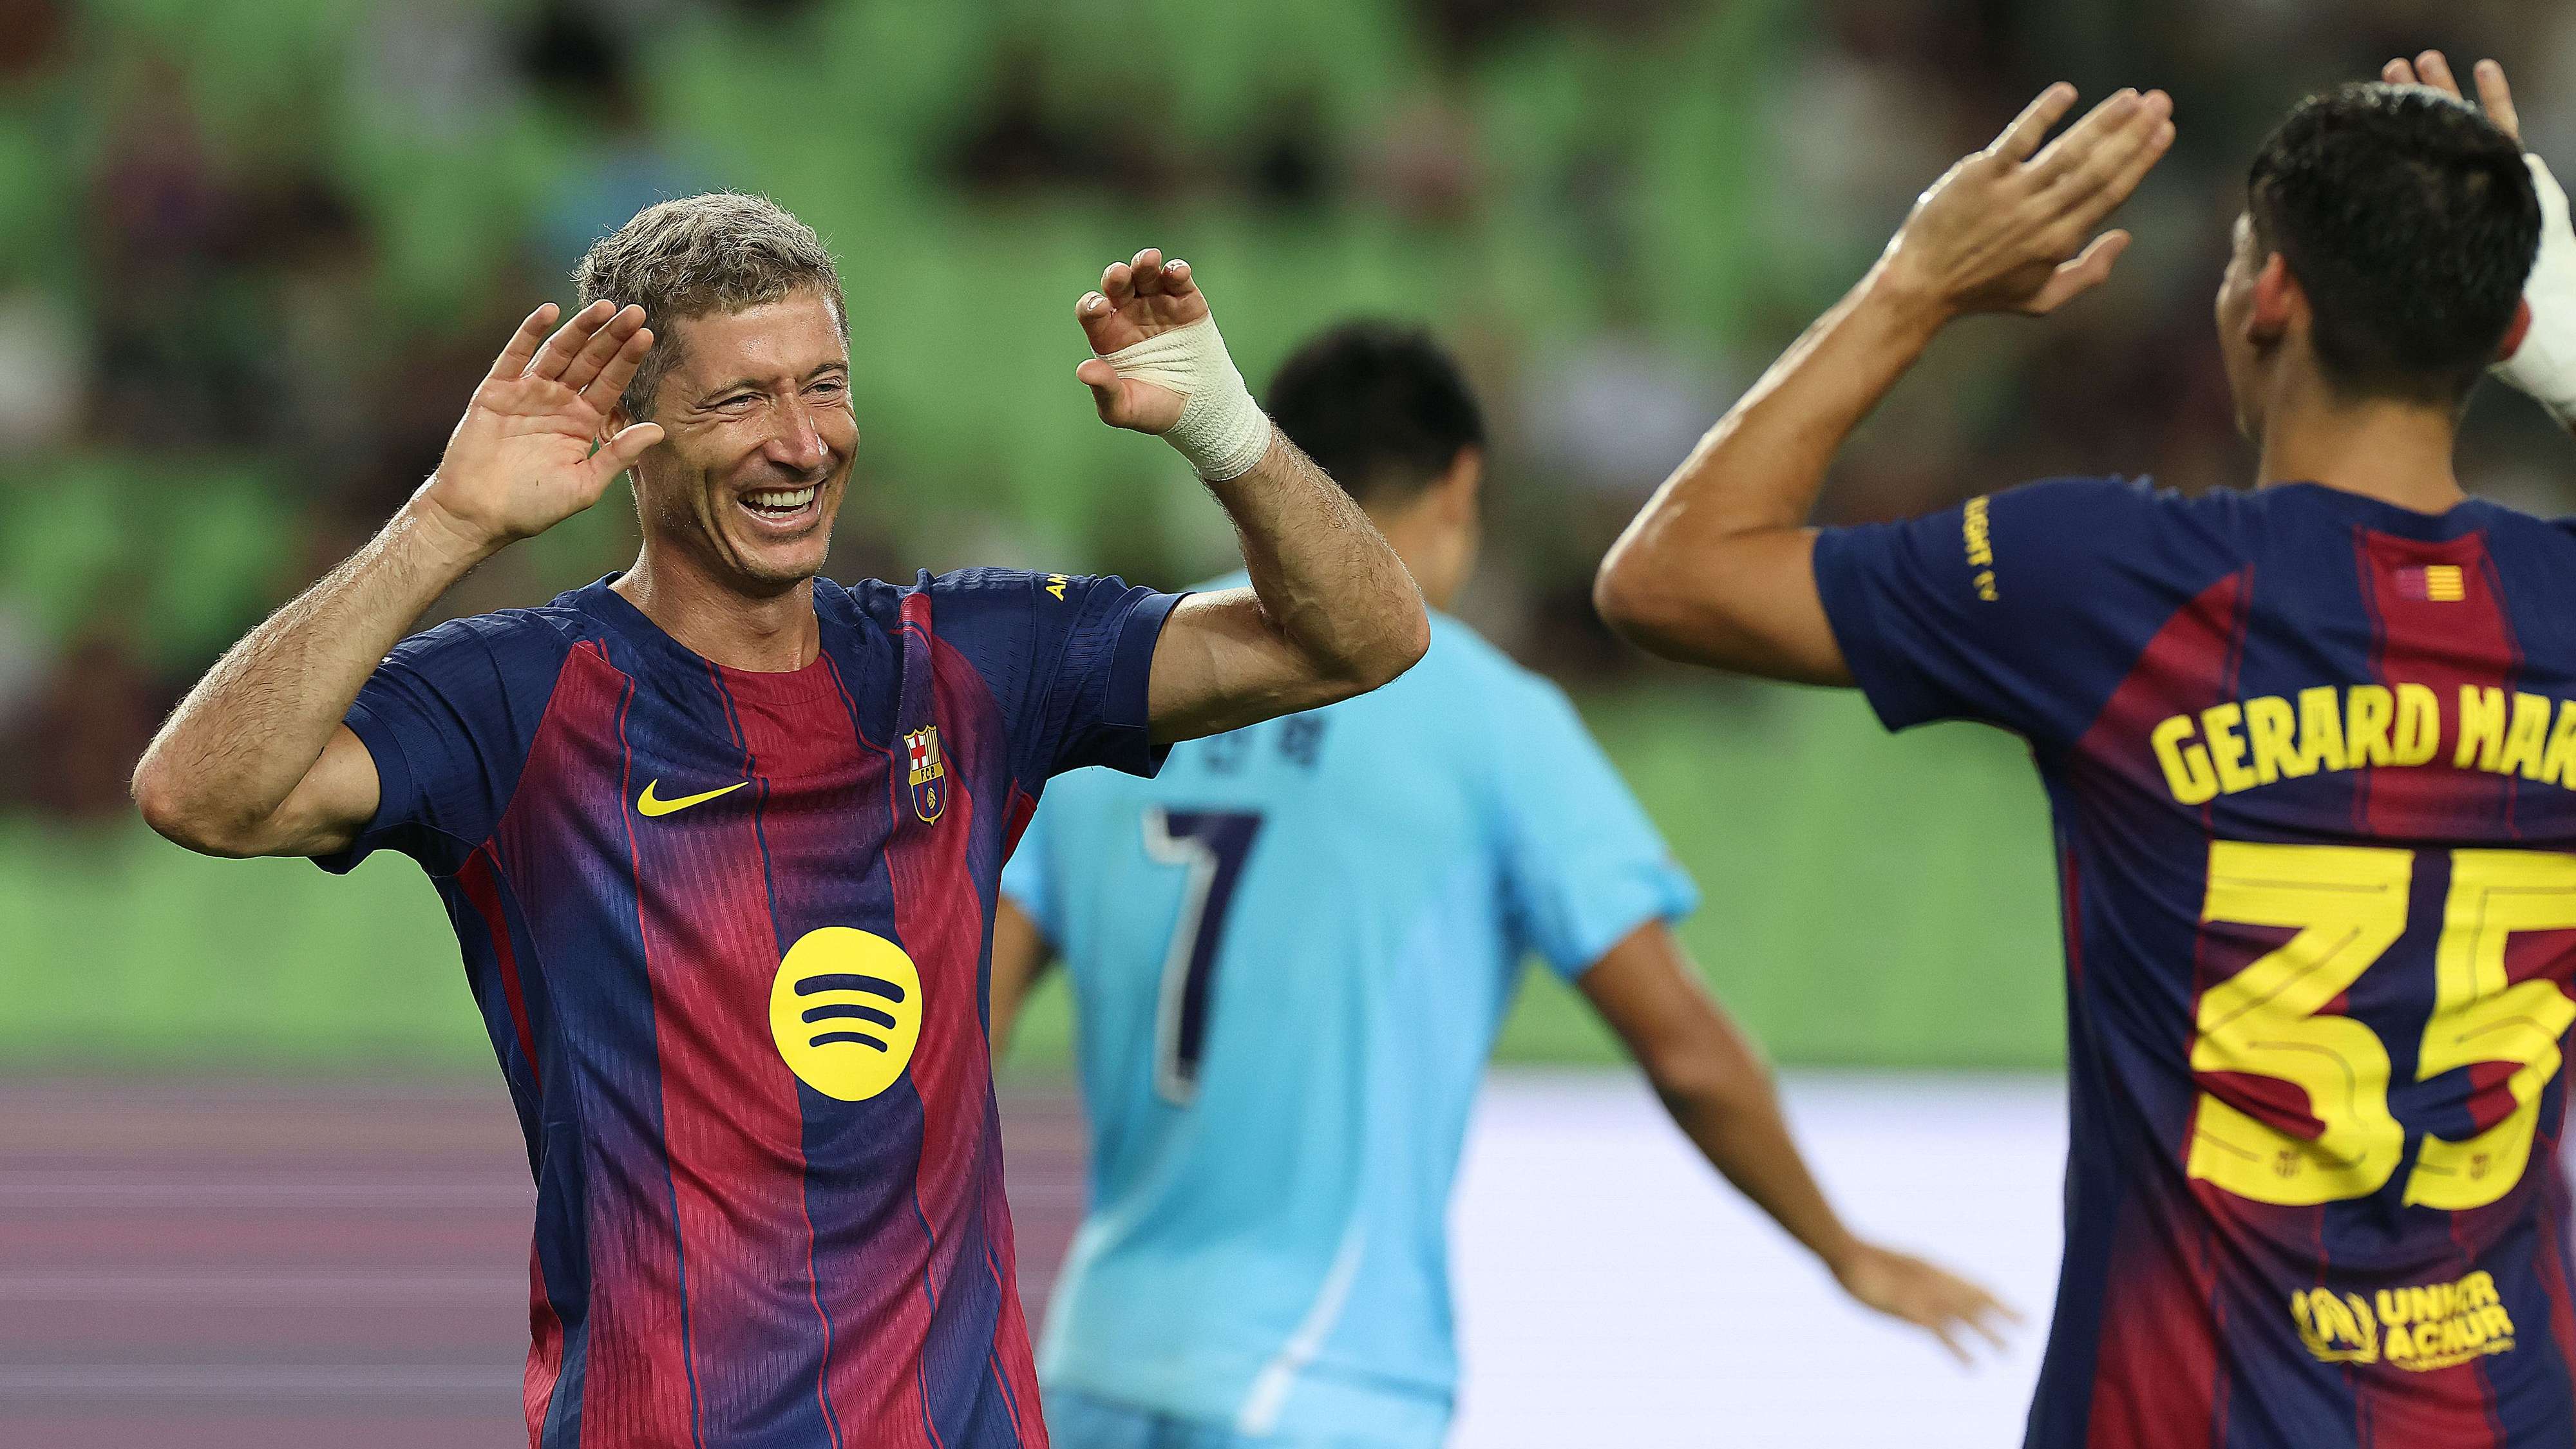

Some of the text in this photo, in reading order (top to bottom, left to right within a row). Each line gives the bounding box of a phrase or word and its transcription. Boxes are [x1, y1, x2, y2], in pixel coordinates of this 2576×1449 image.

[921, 766, 935, 781] FCB
[2150, 683, 2441, 804] GERARD
[1142, 800, 1265, 1108] 7
[2187, 841, 2576, 1210] 35
